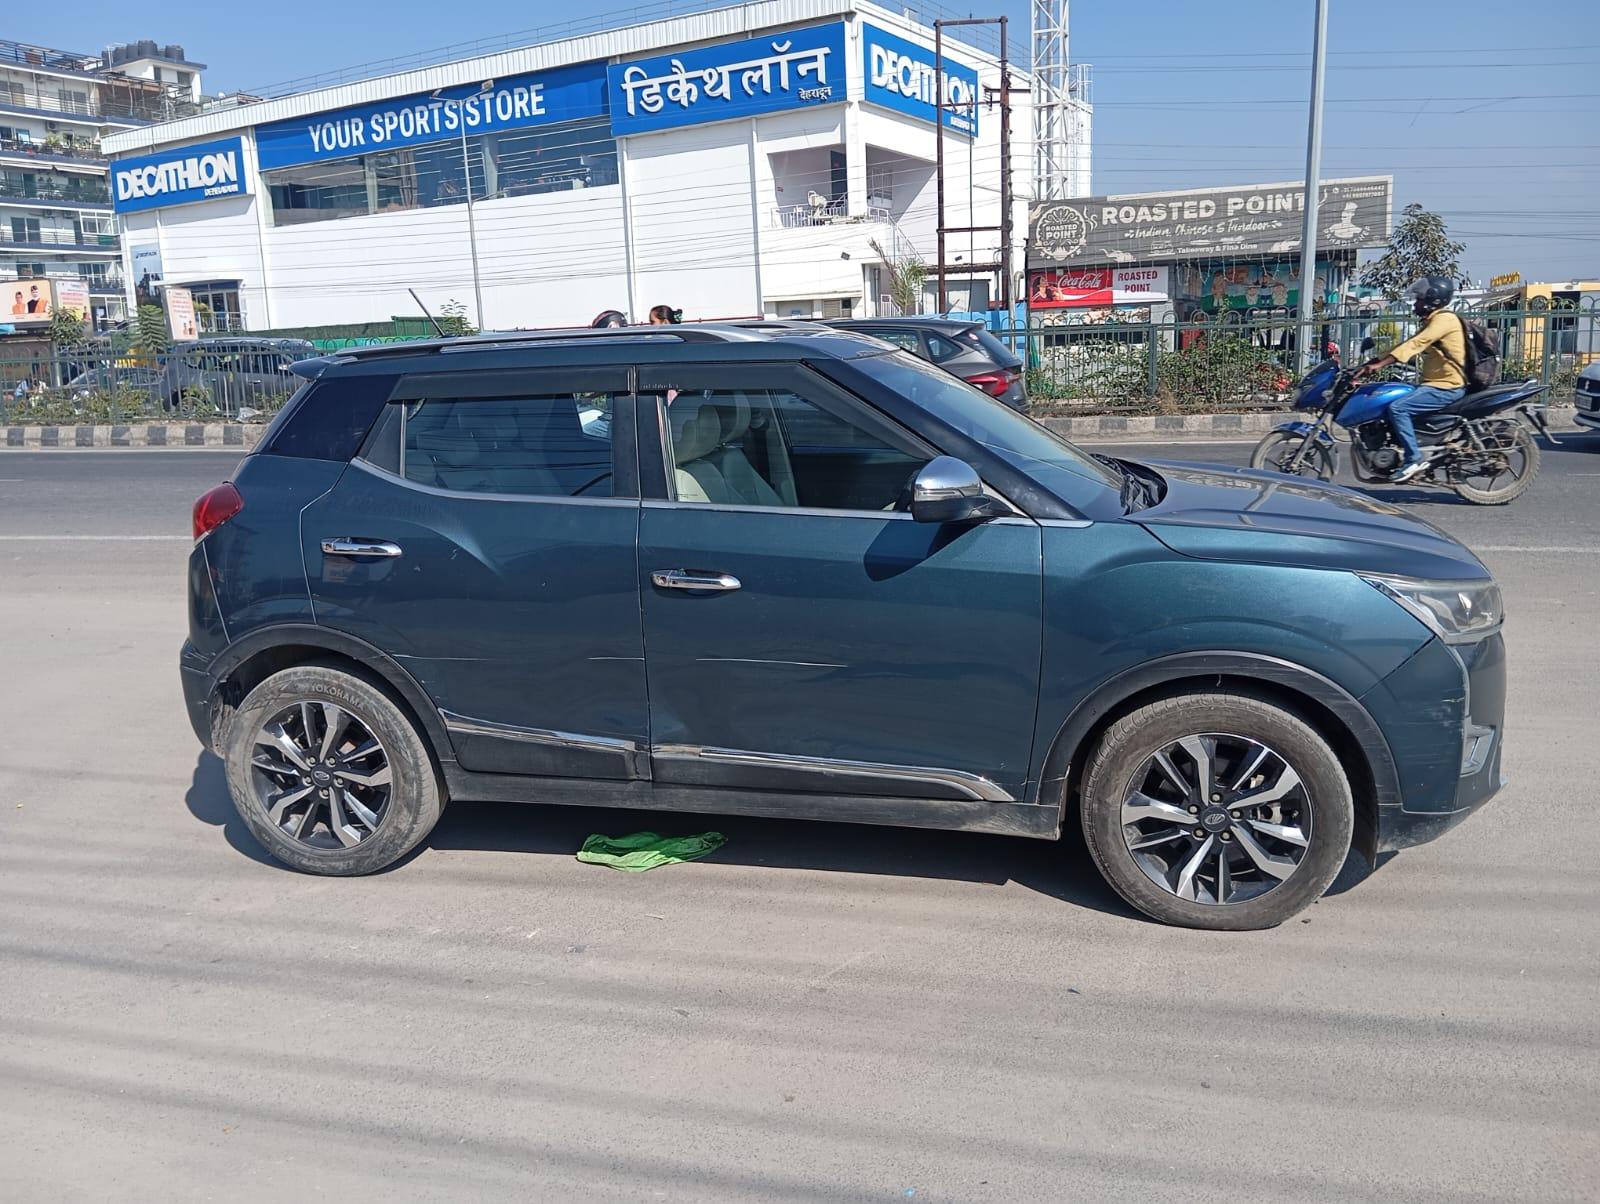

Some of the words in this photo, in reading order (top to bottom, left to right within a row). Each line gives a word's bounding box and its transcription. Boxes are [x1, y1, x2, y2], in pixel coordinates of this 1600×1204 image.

[620, 39, 832, 116] डिकैथलॉन
[798, 86, 832, 100] देहरादून
[308, 118, 365, 153] YOUR
[370, 101, 459, 143] SPORTS
[466, 83, 546, 127] STORE
[116, 151, 238, 201] DECATHLON
[1102, 199, 1216, 226] ROASTED
[1227, 192, 1306, 217] POINT
[1046, 223, 1078, 232] ROASTED
[1046, 230, 1078, 240] POINT
[1118, 270, 1158, 281] ROASTED
[1125, 283, 1151, 293] POINT
[310, 682, 364, 712] YOKOHAMA
